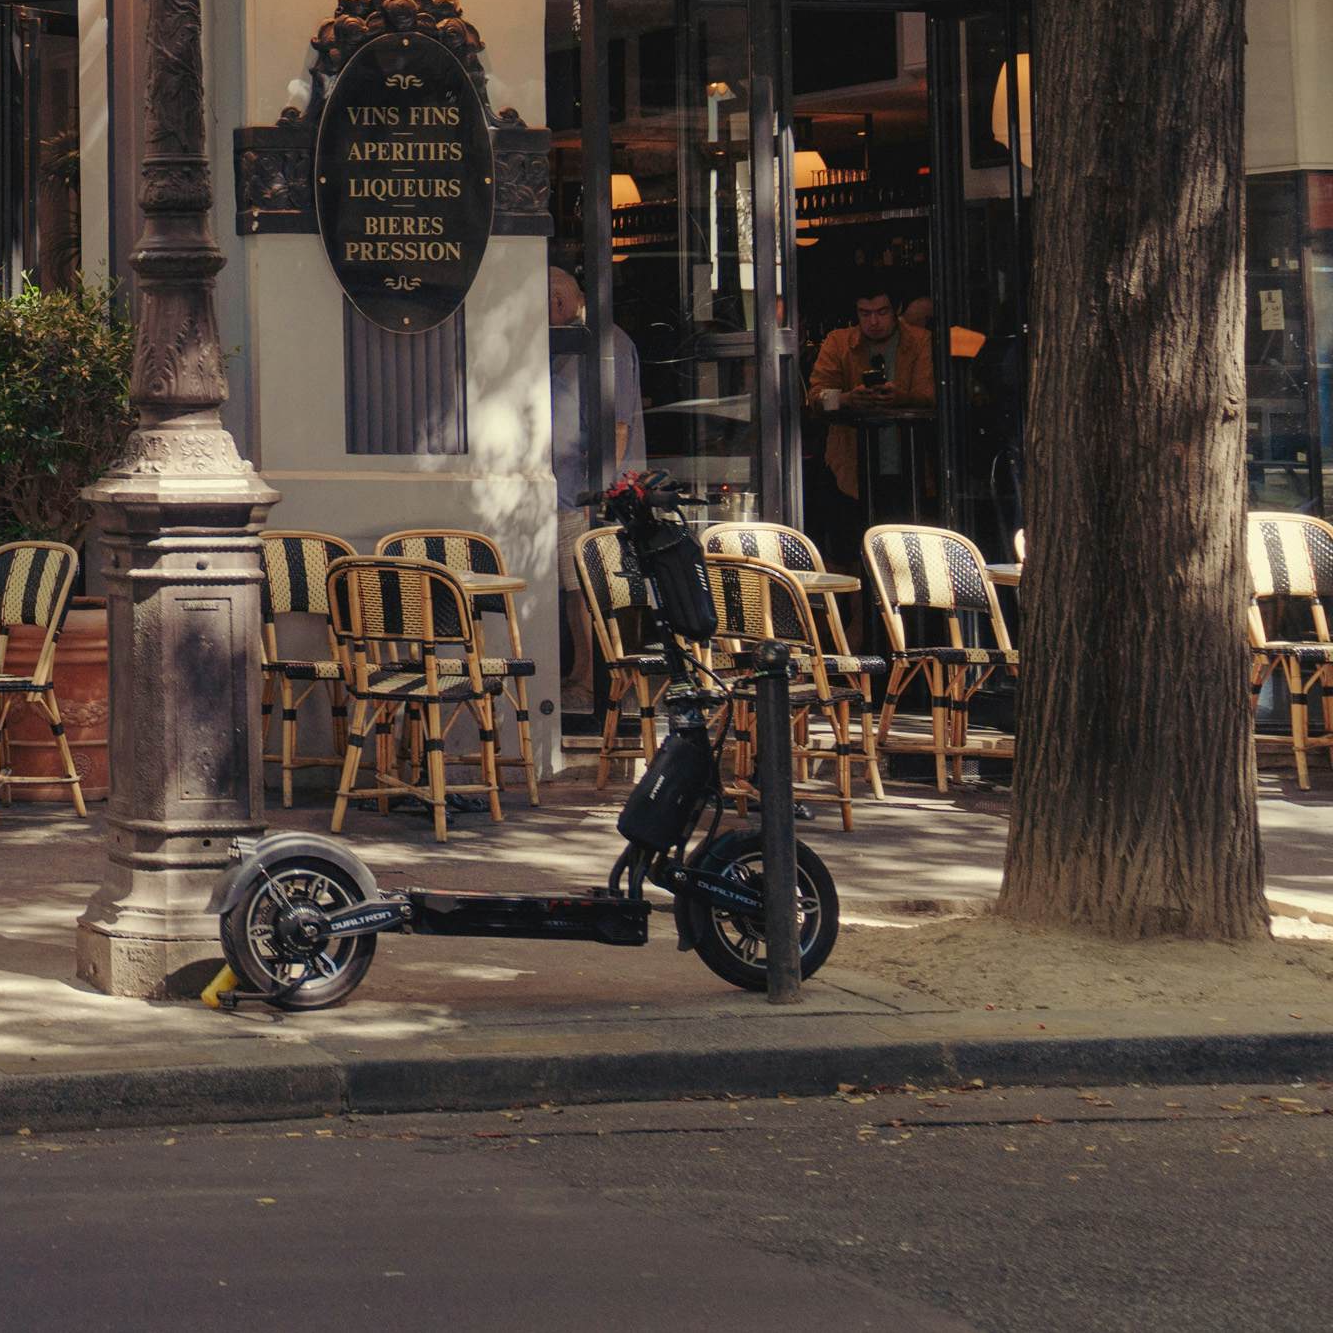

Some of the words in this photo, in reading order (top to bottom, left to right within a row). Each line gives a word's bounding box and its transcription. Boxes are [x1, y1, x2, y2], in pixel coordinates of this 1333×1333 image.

[346, 106, 400, 126] VINS
[409, 106, 460, 126] FINS
[347, 141, 463, 162] APERITIFS
[348, 178, 462, 201] LIQUEURS
[364, 216, 444, 236] BIERES
[344, 241, 462, 261] PRESSION
[330, 910, 392, 931] DUALTRON
